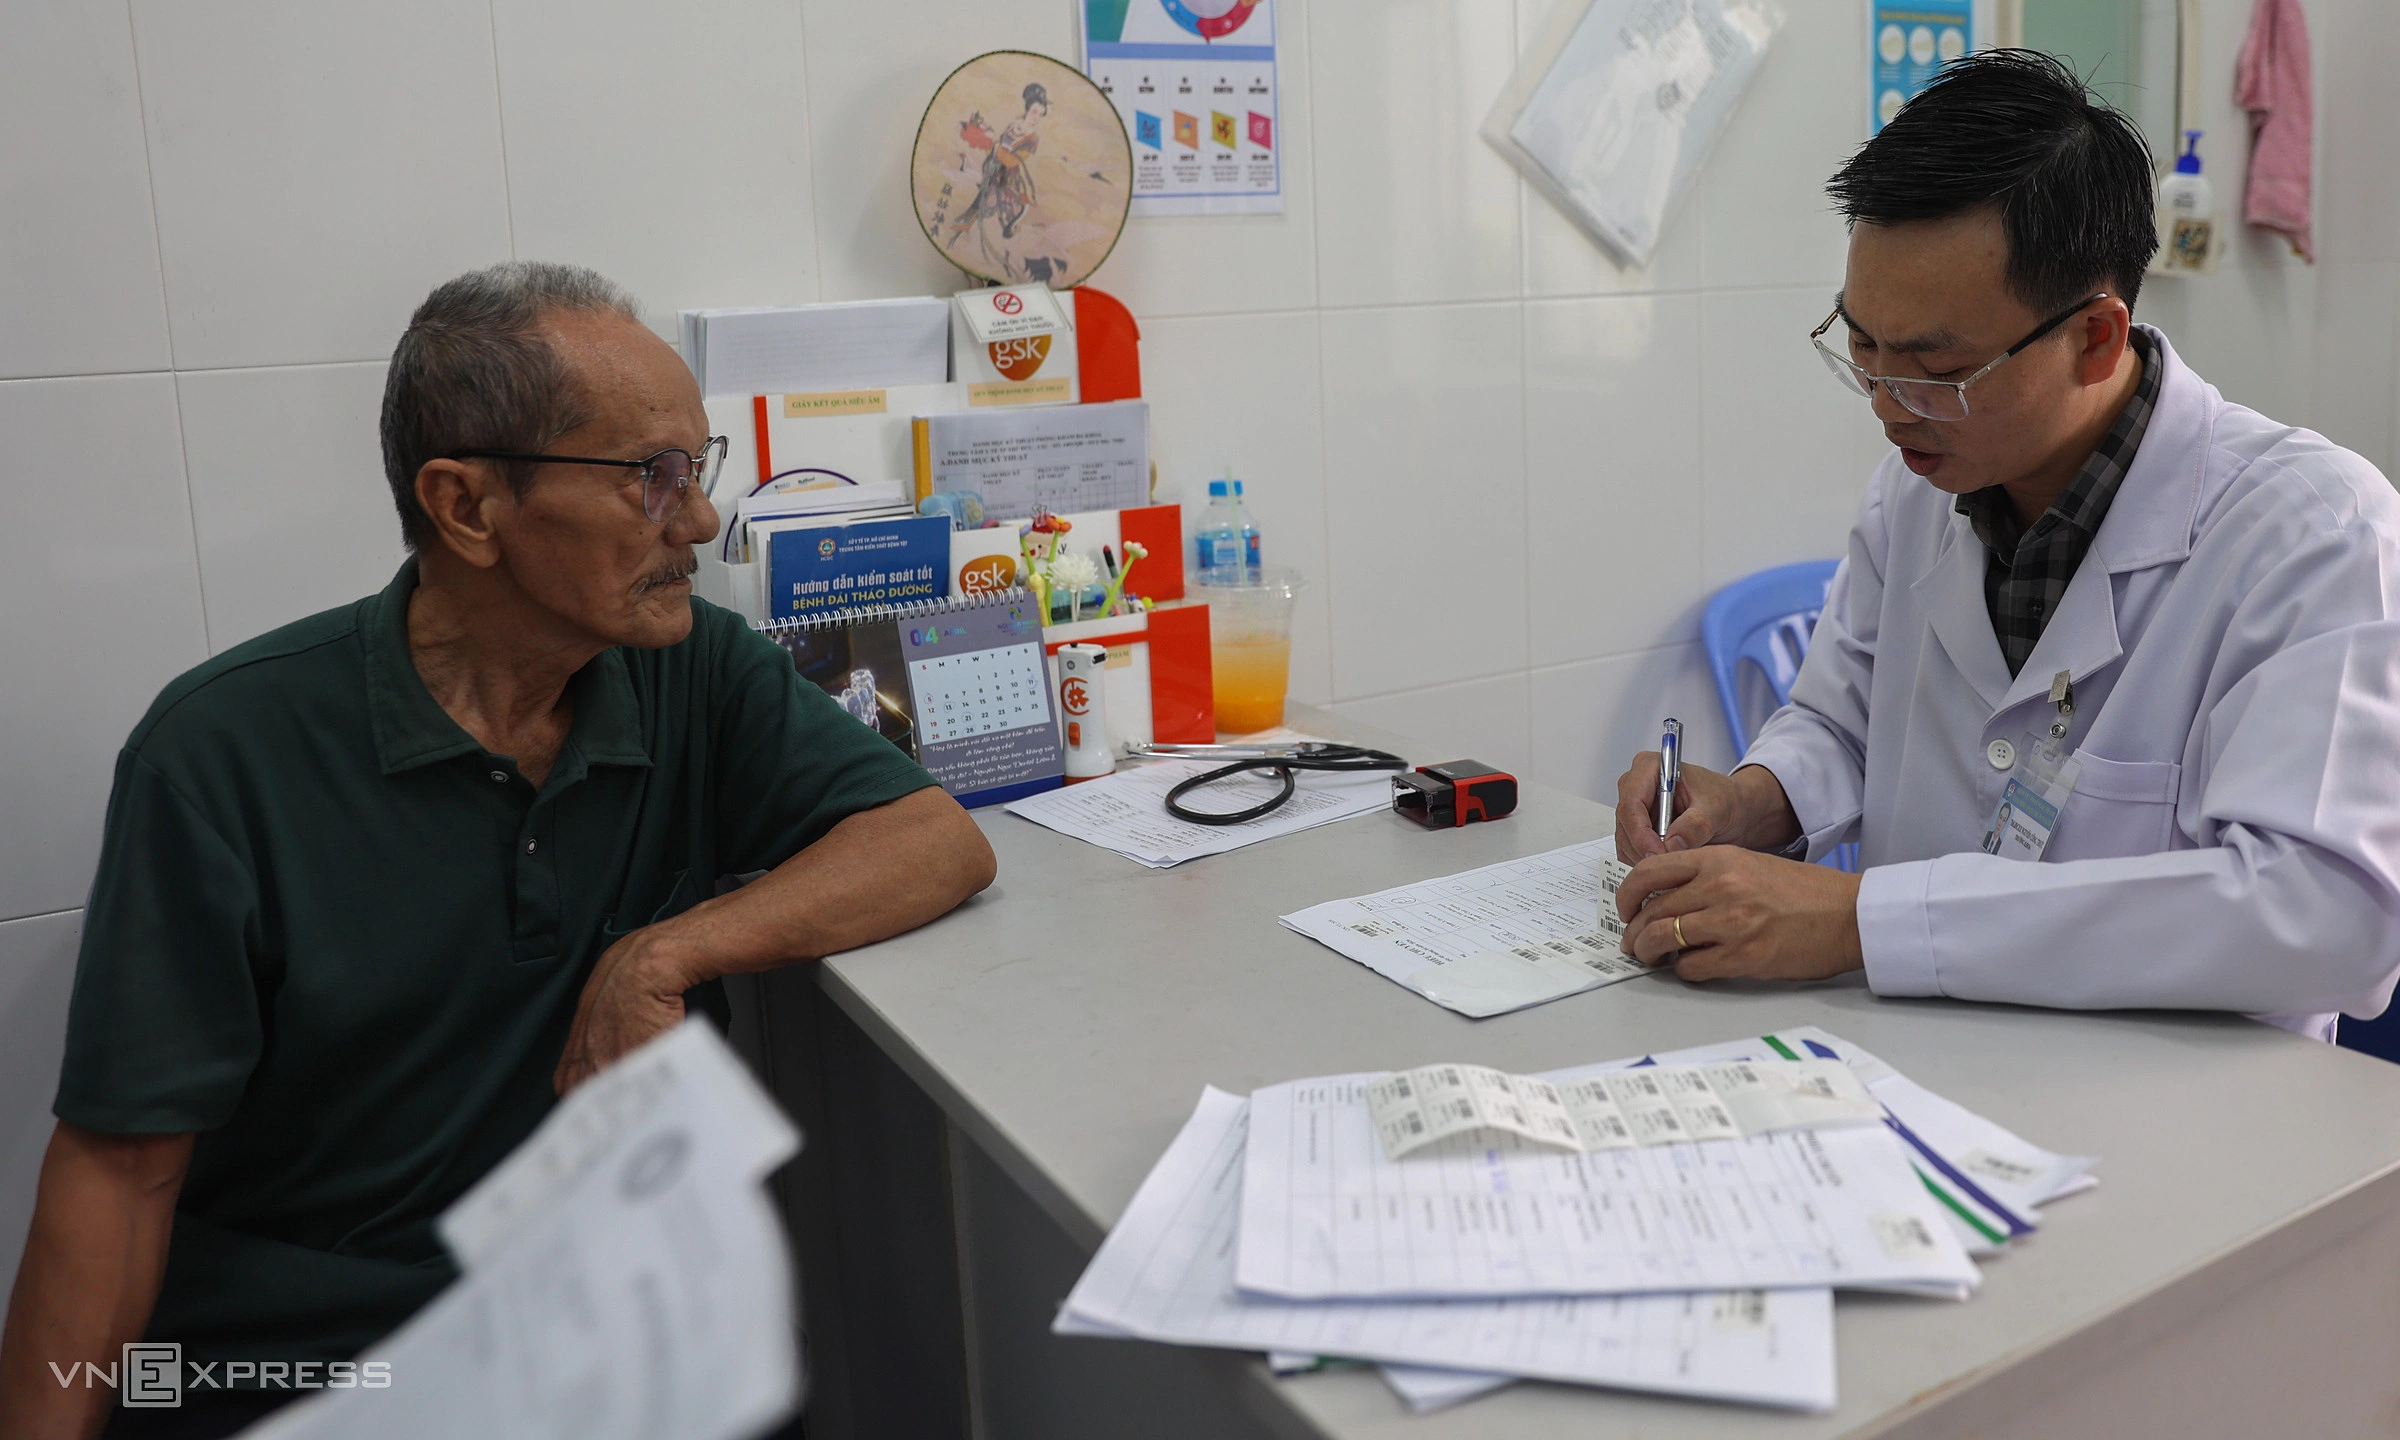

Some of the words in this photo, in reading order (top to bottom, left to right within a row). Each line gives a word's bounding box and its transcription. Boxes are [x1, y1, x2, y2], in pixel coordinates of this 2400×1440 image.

[995, 337, 1043, 369] gsk
[793, 579, 829, 595] Hướng
[833, 573, 854, 591] dẫn
[857, 569, 886, 587] kiểm
[889, 567, 914, 584] soát
[917, 564, 933, 581] tốt
[965, 562, 1008, 596] gsk
[793, 595, 824, 610] BỆNH
[827, 591, 848, 606] ĐÁI
[851, 588, 886, 602] THÁO
[889, 583, 933, 598] ĐƯỜNG
[910, 626, 939, 647] 04
[944, 627, 967, 637] APRIL
